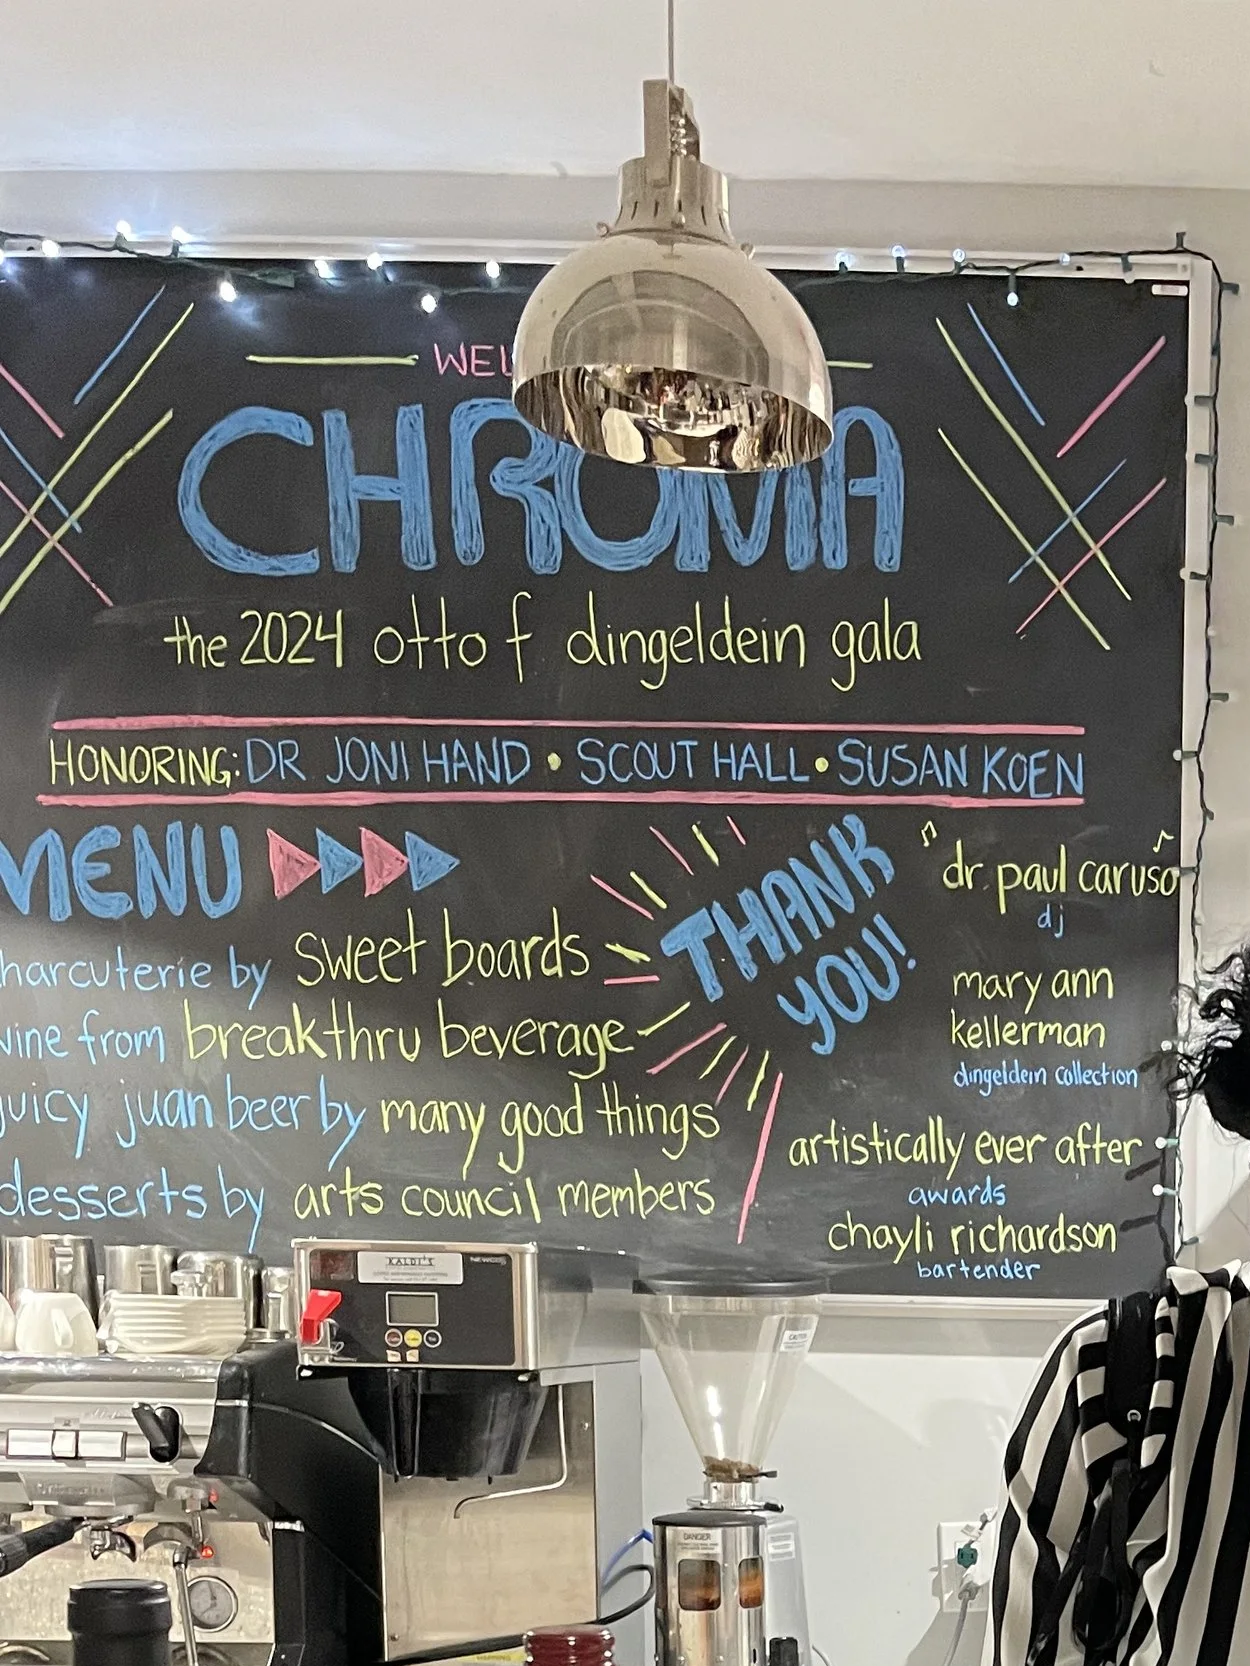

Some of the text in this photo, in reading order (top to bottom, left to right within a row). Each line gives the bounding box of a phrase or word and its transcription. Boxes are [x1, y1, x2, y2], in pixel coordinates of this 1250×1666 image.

[178, 396, 905, 574] CHROMA
[164, 591, 922, 691] the 2024 otto f dingeldein gala
[49, 737, 1084, 797] HONORING: DR JONI HAND SCOUT HALL SUSAN KOEN
[0, 820, 242, 922] MENU
[659, 813, 896, 1002] THANK
[942, 838, 1180, 915] dr paul caruso
[0, 907, 590, 1010] harcuterie by sweet boards
[1036, 903, 1066, 940] dj
[775, 912, 917, 1056] YOU!
[951, 965, 1114, 1013] mary ann
[78, 1009, 165, 1065] from
[183, 999, 421, 1063] breakthru
[438, 997, 634, 1079] beverage
[950, 1008, 1106, 1050] kellerman
[953, 1064, 1138, 1098] dingeldein collection
[115, 1078, 213, 1149] juan
[227, 1074, 311, 1131] beer
[321, 1074, 366, 1171] by
[380, 1094, 486, 1181] many
[498, 1083, 586, 1175] good
[596, 1083, 720, 1160] things
[788, 1115, 1143, 1181] artistically ever after
[0, 1157, 716, 1254] desserts by arts council members
[908, 1176, 1006, 1207] awards
[827, 1210, 1117, 1265] chayli richardson
[917, 1256, 1041, 1280] bartender
